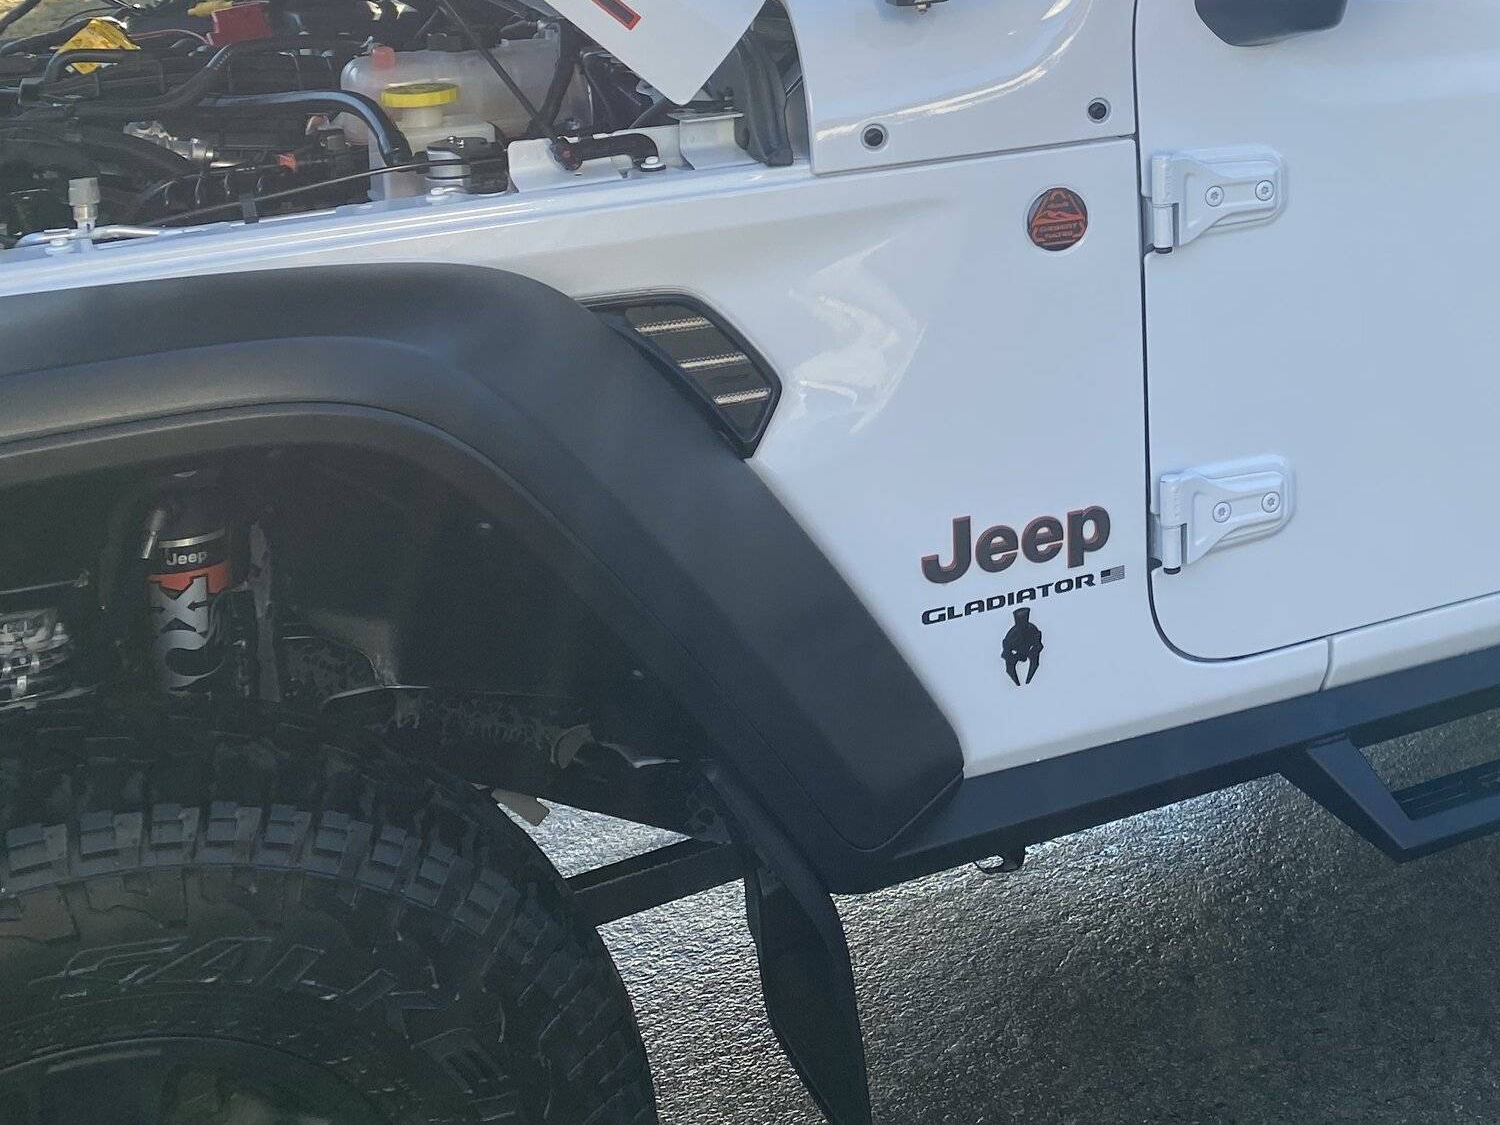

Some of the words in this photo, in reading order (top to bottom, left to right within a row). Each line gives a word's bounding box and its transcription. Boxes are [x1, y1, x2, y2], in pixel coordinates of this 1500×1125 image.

[166, 551, 209, 567] Jeep
[921, 505, 1111, 584] Jeep
[921, 573, 1096, 625] GLADIATOR
